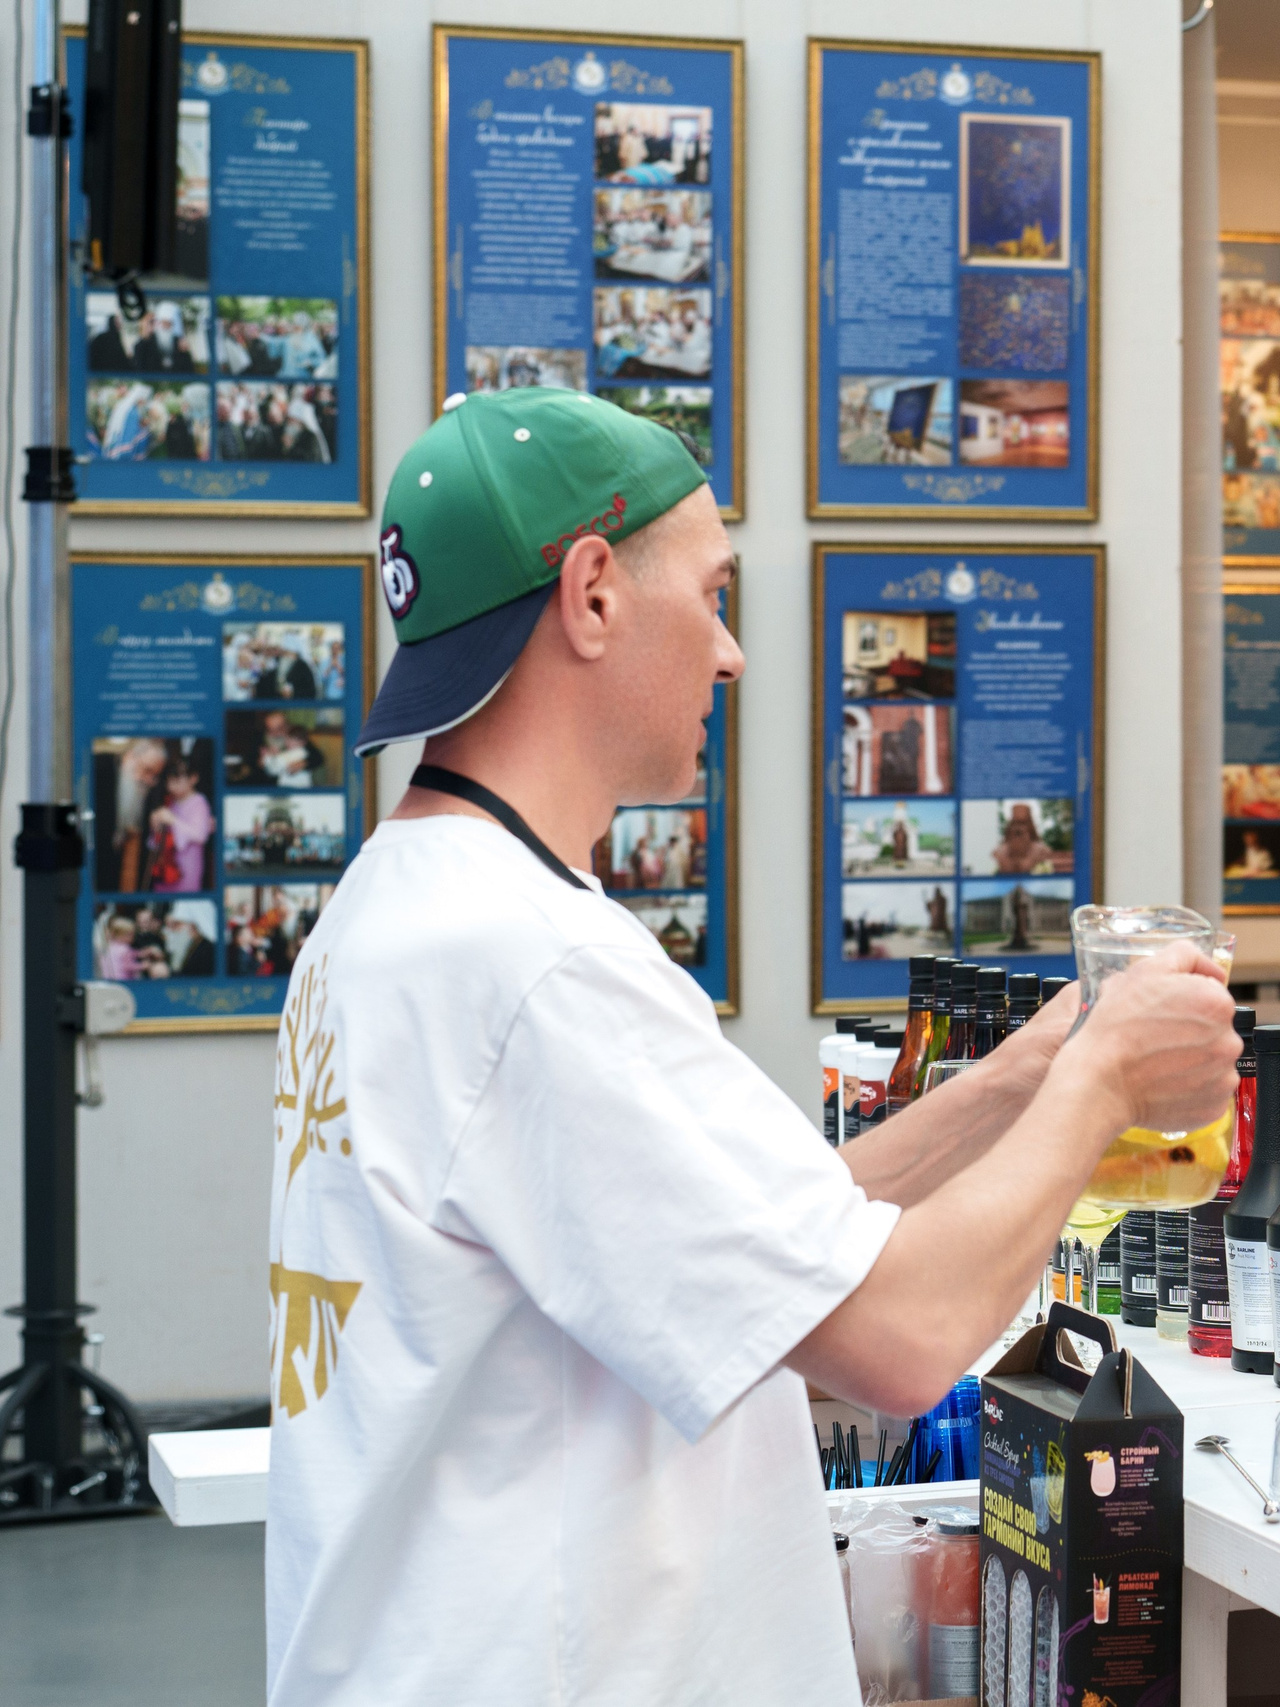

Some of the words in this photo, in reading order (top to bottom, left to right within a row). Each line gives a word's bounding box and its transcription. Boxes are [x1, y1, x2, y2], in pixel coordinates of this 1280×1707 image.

[541, 510, 624, 567] BOSCO
[1121, 1446, 1160, 1456] СТРОЙНЫЙ
[984, 1486, 1014, 1524] СОЗДАЙ
[1014, 1503, 1036, 1537] СВОЮ
[984, 1511, 1025, 1556] ГАРМОНИЮ
[1025, 1536, 1051, 1572] ВКУСА
[1119, 1571, 1160, 1581] АРБАТСКИЙ
[1119, 1581, 1154, 1591] ЛИМОНАД
